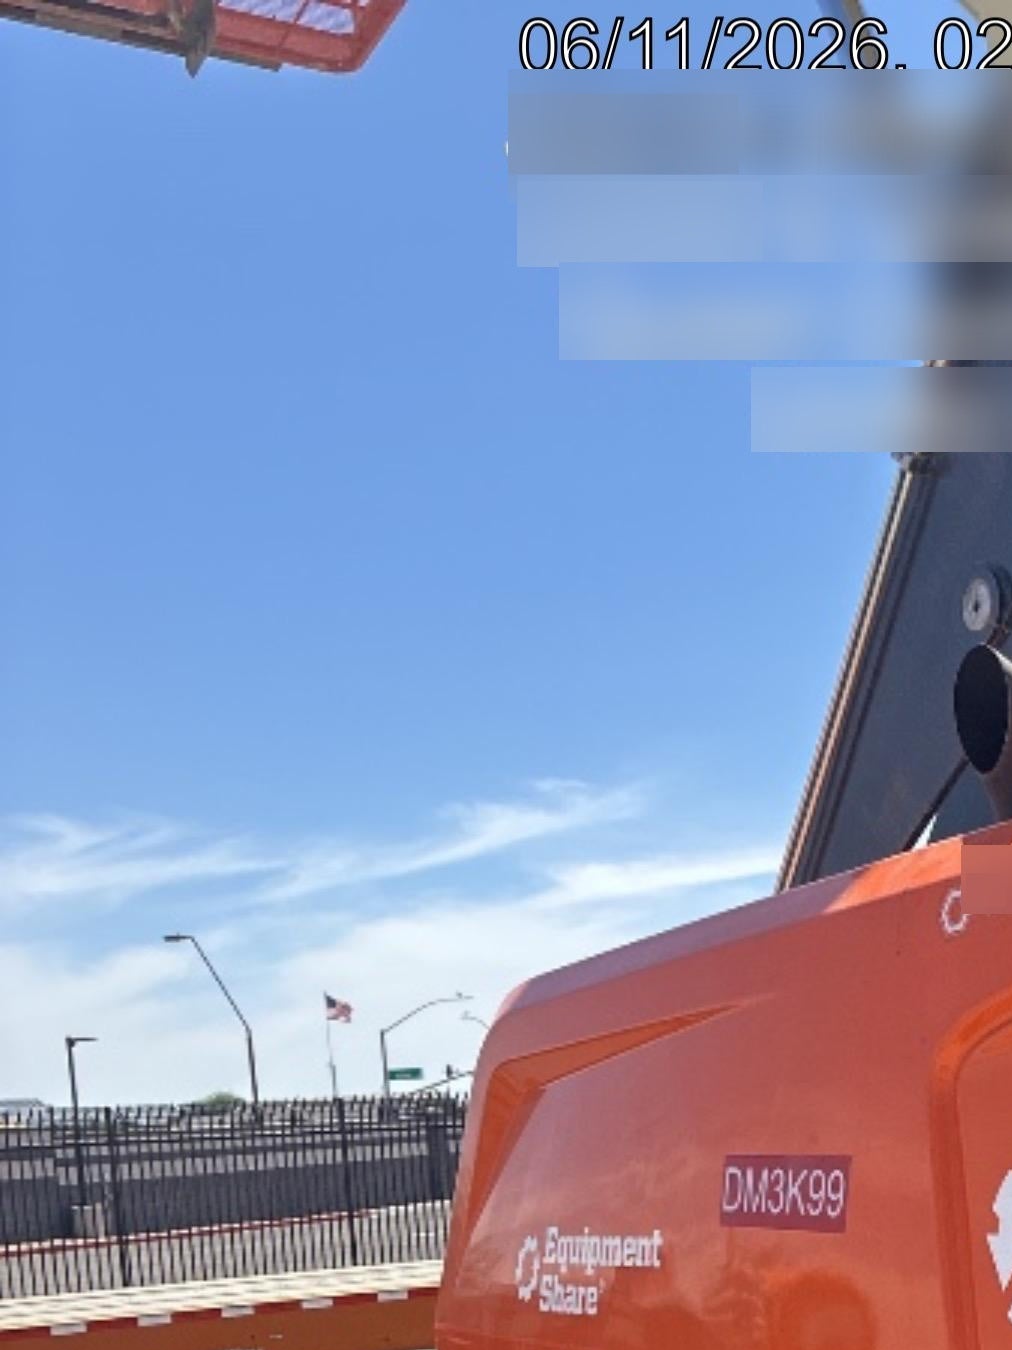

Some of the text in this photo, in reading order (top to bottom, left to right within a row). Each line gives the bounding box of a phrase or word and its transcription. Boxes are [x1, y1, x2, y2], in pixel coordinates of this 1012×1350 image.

[721, 1165, 845, 1218] DM3K99
[542, 1226, 662, 1275] Equipment
[539, 1274, 598, 1315] Share
